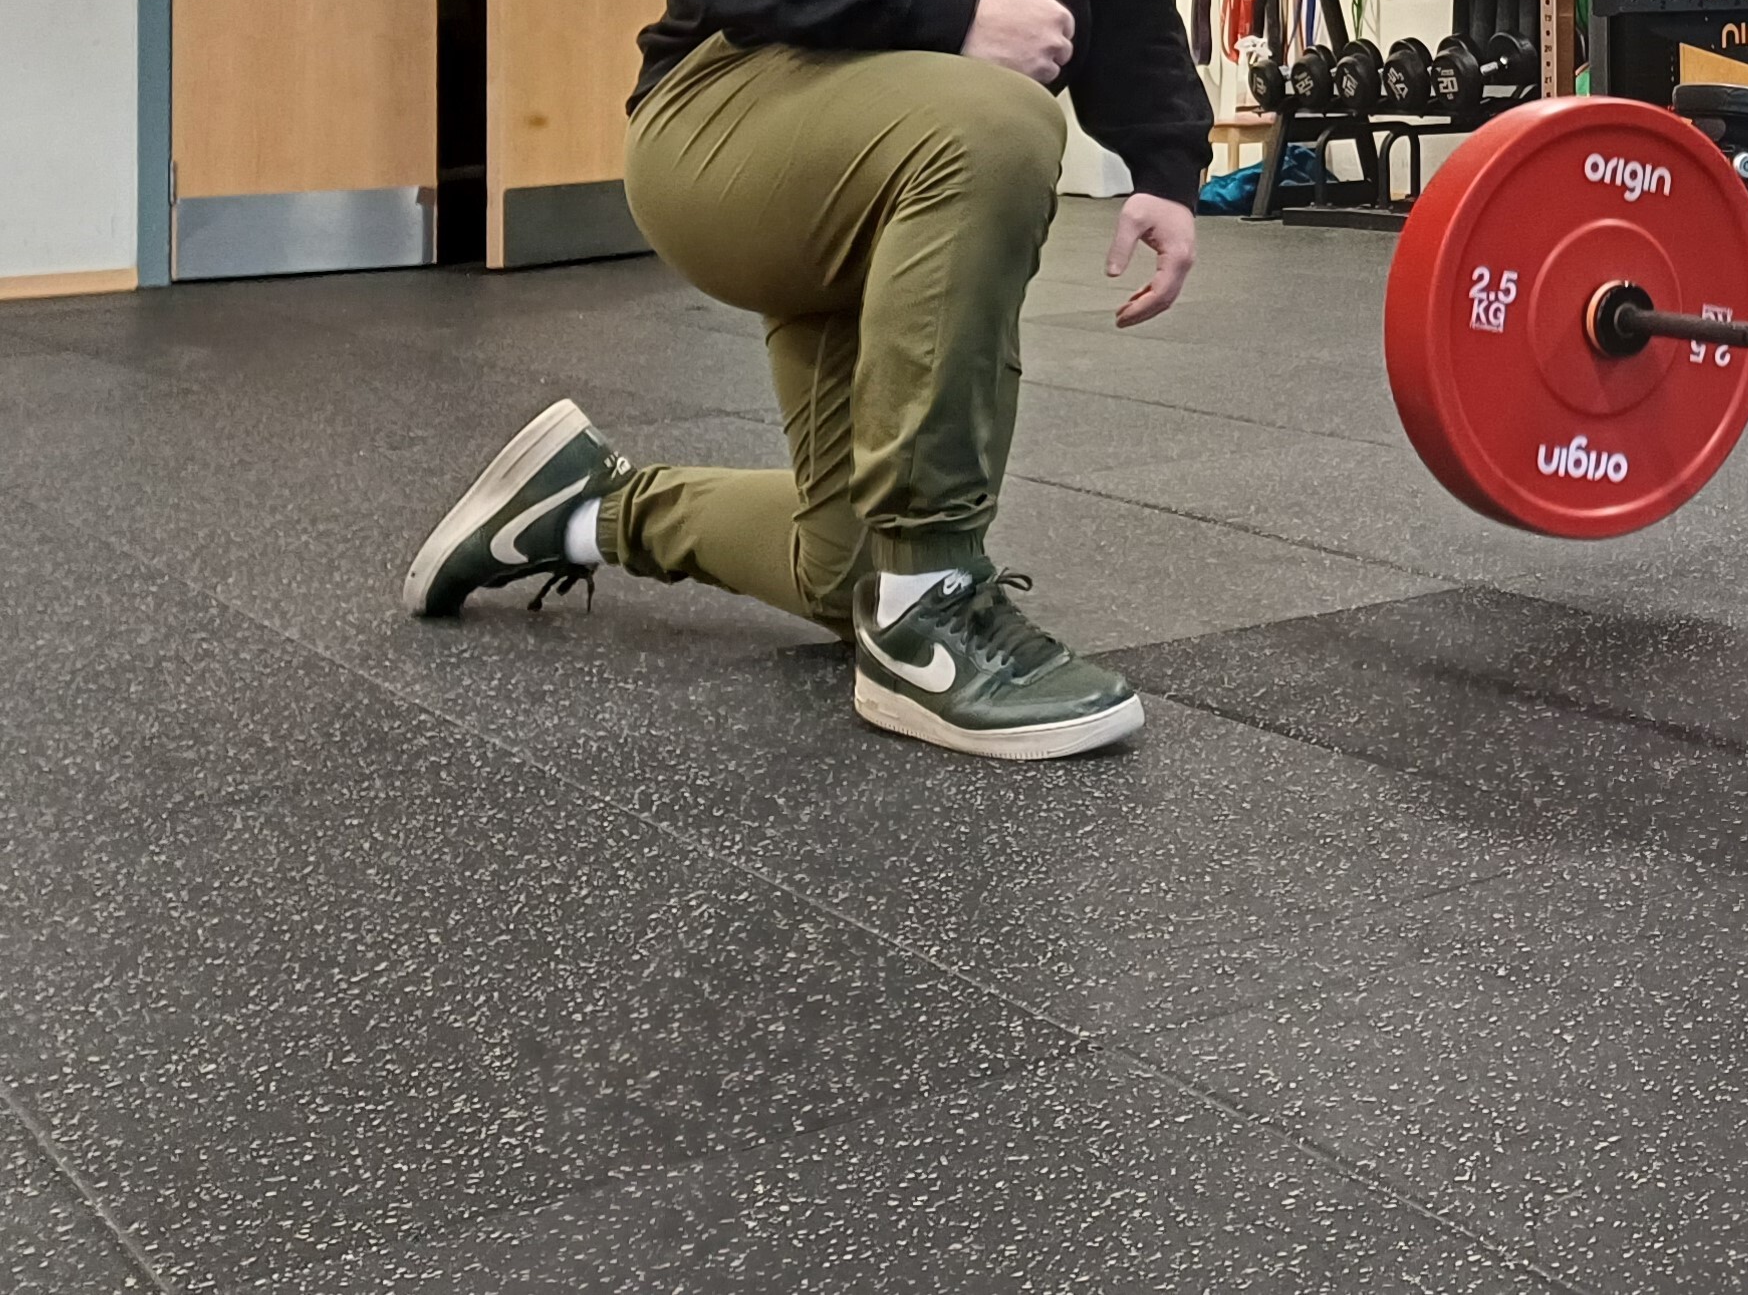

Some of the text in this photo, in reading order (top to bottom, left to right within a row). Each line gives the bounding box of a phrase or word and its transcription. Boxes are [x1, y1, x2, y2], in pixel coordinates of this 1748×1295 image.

[1438, 76, 1459, 94] 20
[1584, 153, 1671, 202] origin
[1469, 266, 1518, 304] 2.5
[1471, 298, 1506, 328] KG
[1537, 435, 1628, 482] origin
